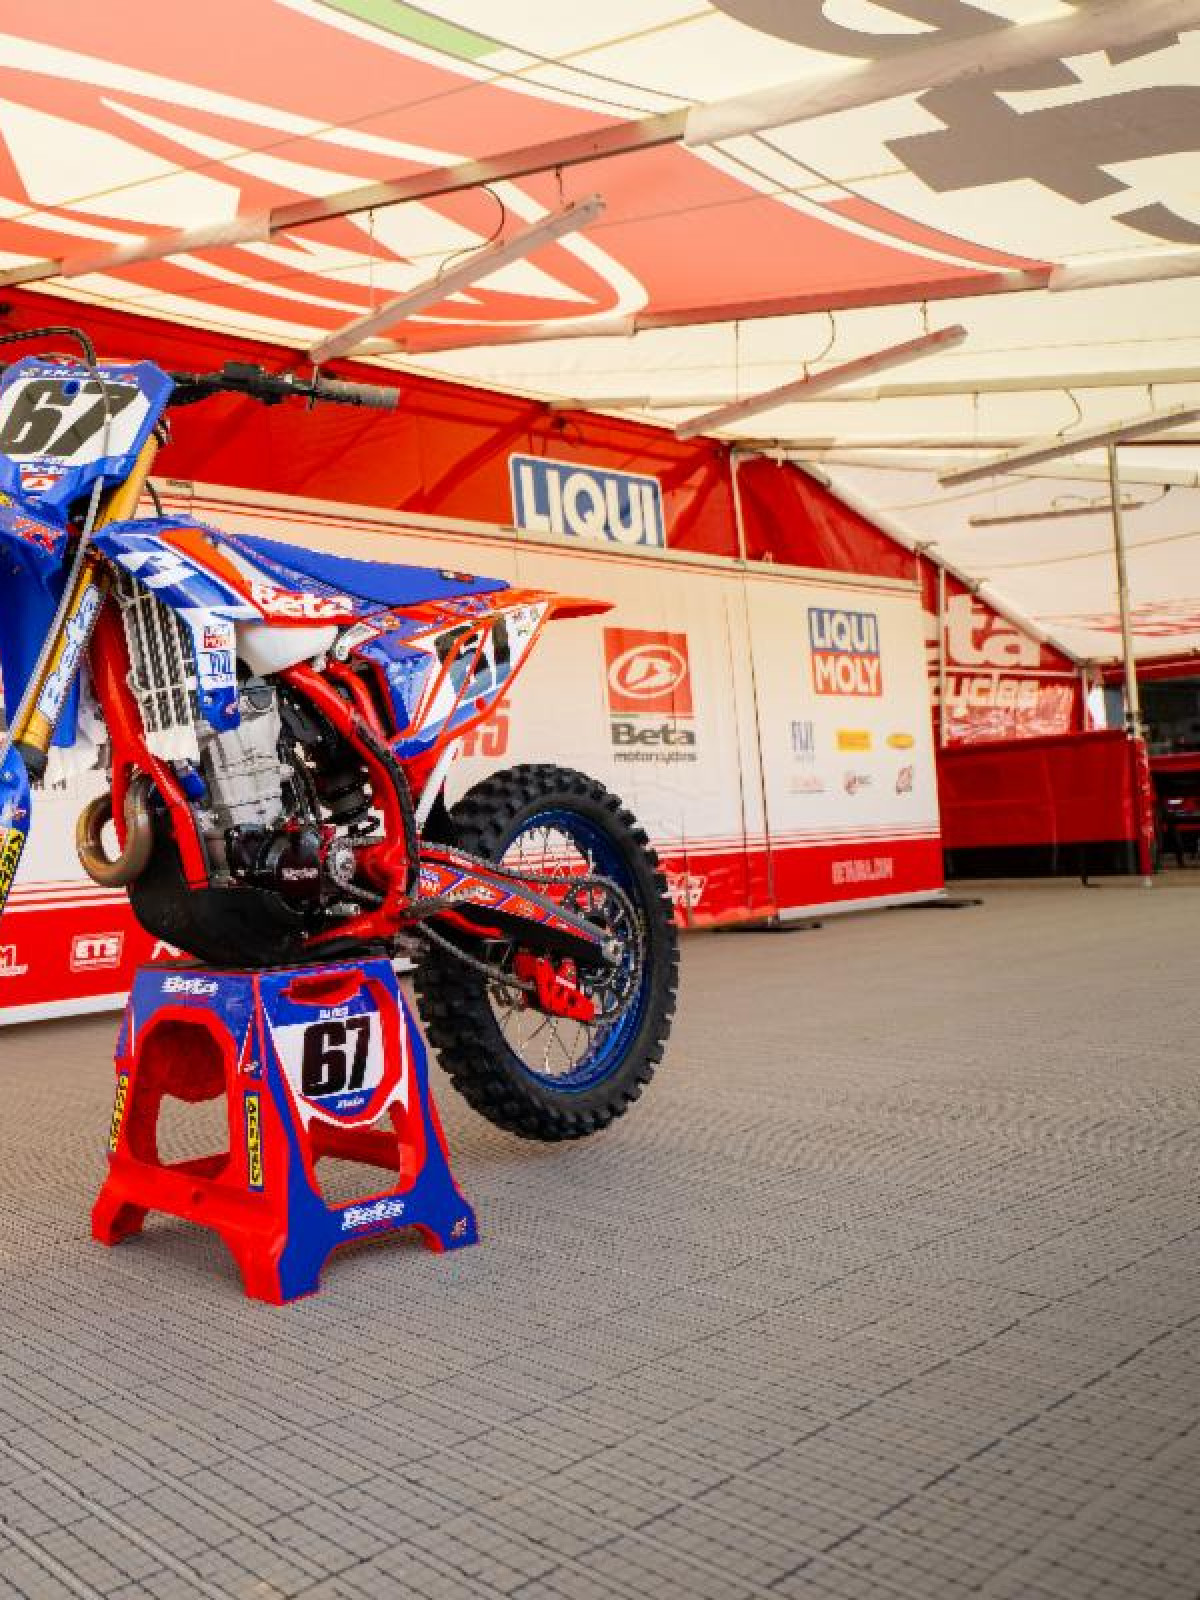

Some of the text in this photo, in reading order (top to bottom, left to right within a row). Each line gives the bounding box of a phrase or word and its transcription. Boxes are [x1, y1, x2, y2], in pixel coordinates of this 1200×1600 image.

[519, 463, 658, 545] LIQUI
[250, 577, 353, 618] Beta
[811, 610, 876, 652] LIQUI
[814, 655, 881, 693] MOLY
[611, 723, 695, 745] Beta
[614, 750, 698, 765] motorcycles
[301, 1015, 371, 1097] 67
